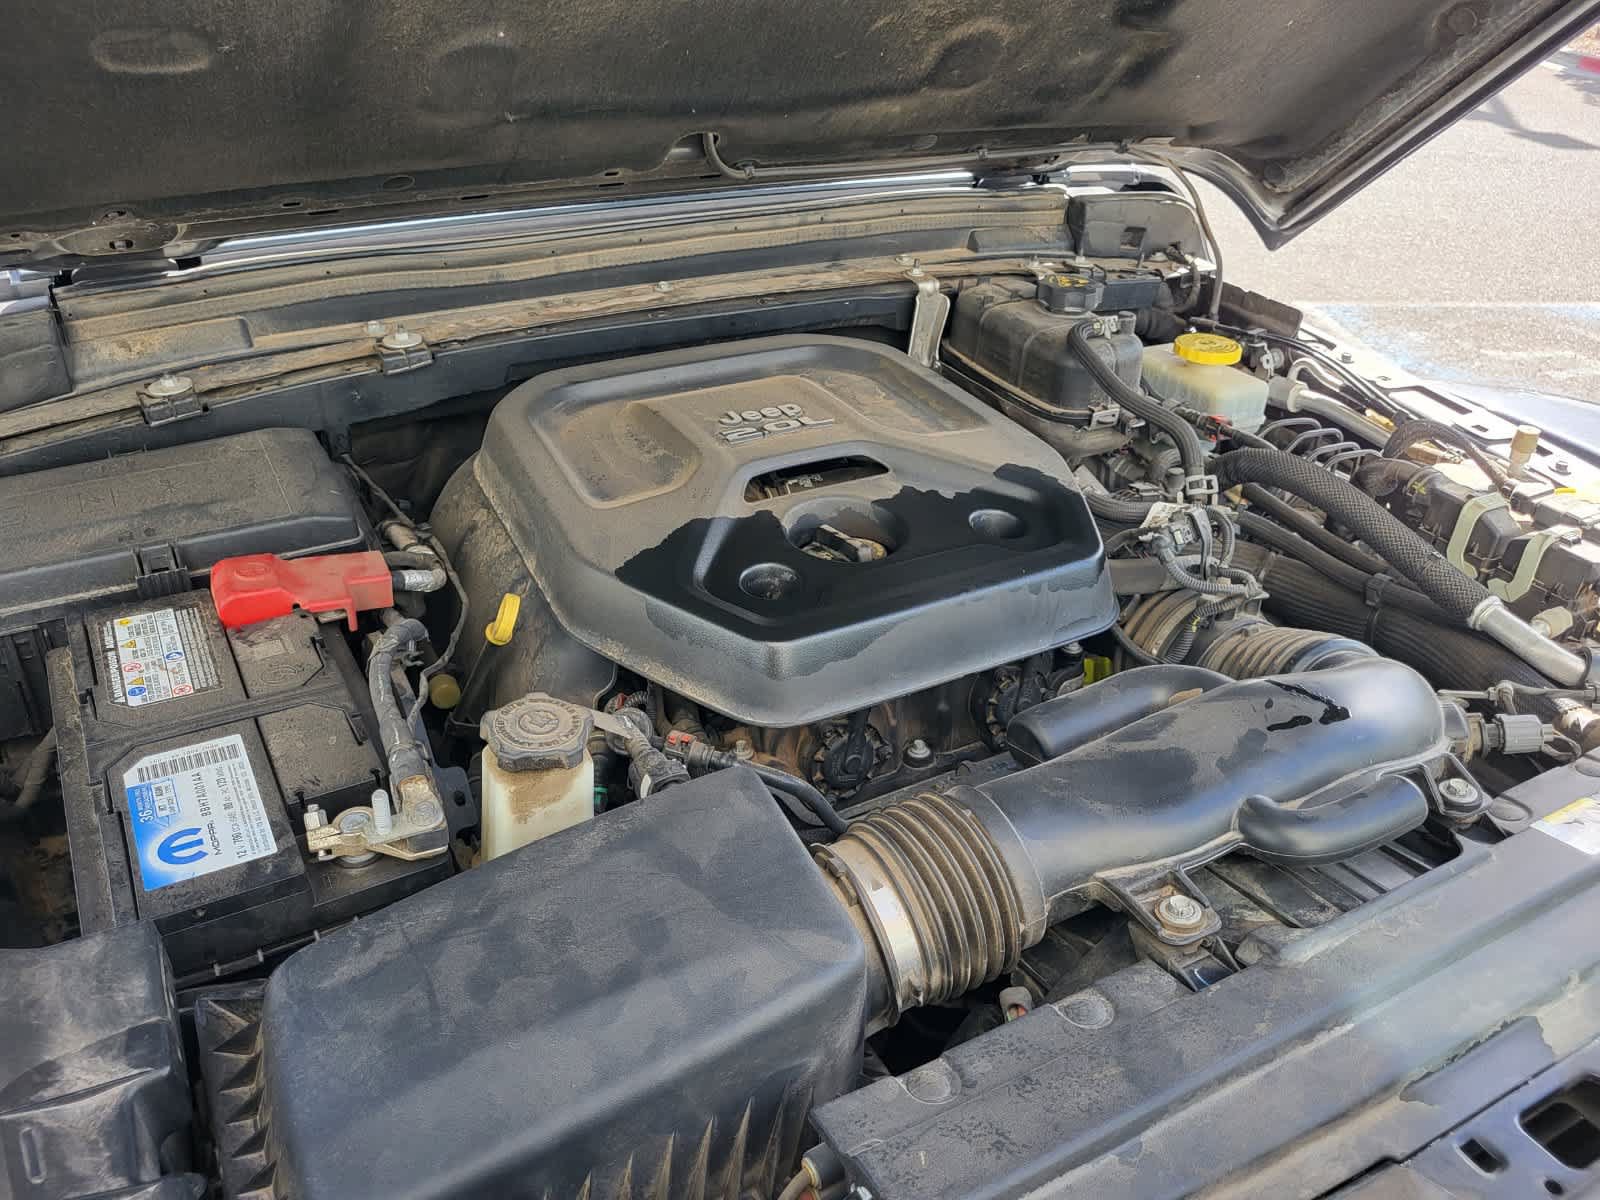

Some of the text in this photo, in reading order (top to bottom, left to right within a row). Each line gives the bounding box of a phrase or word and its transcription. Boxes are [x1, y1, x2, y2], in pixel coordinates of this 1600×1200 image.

[718, 403, 802, 426] Jeep
[718, 416, 835, 445] 2.0L
[139, 810, 154, 824] 36
[207, 821, 223, 856] MOPAR
[236, 850, 248, 859] 12
